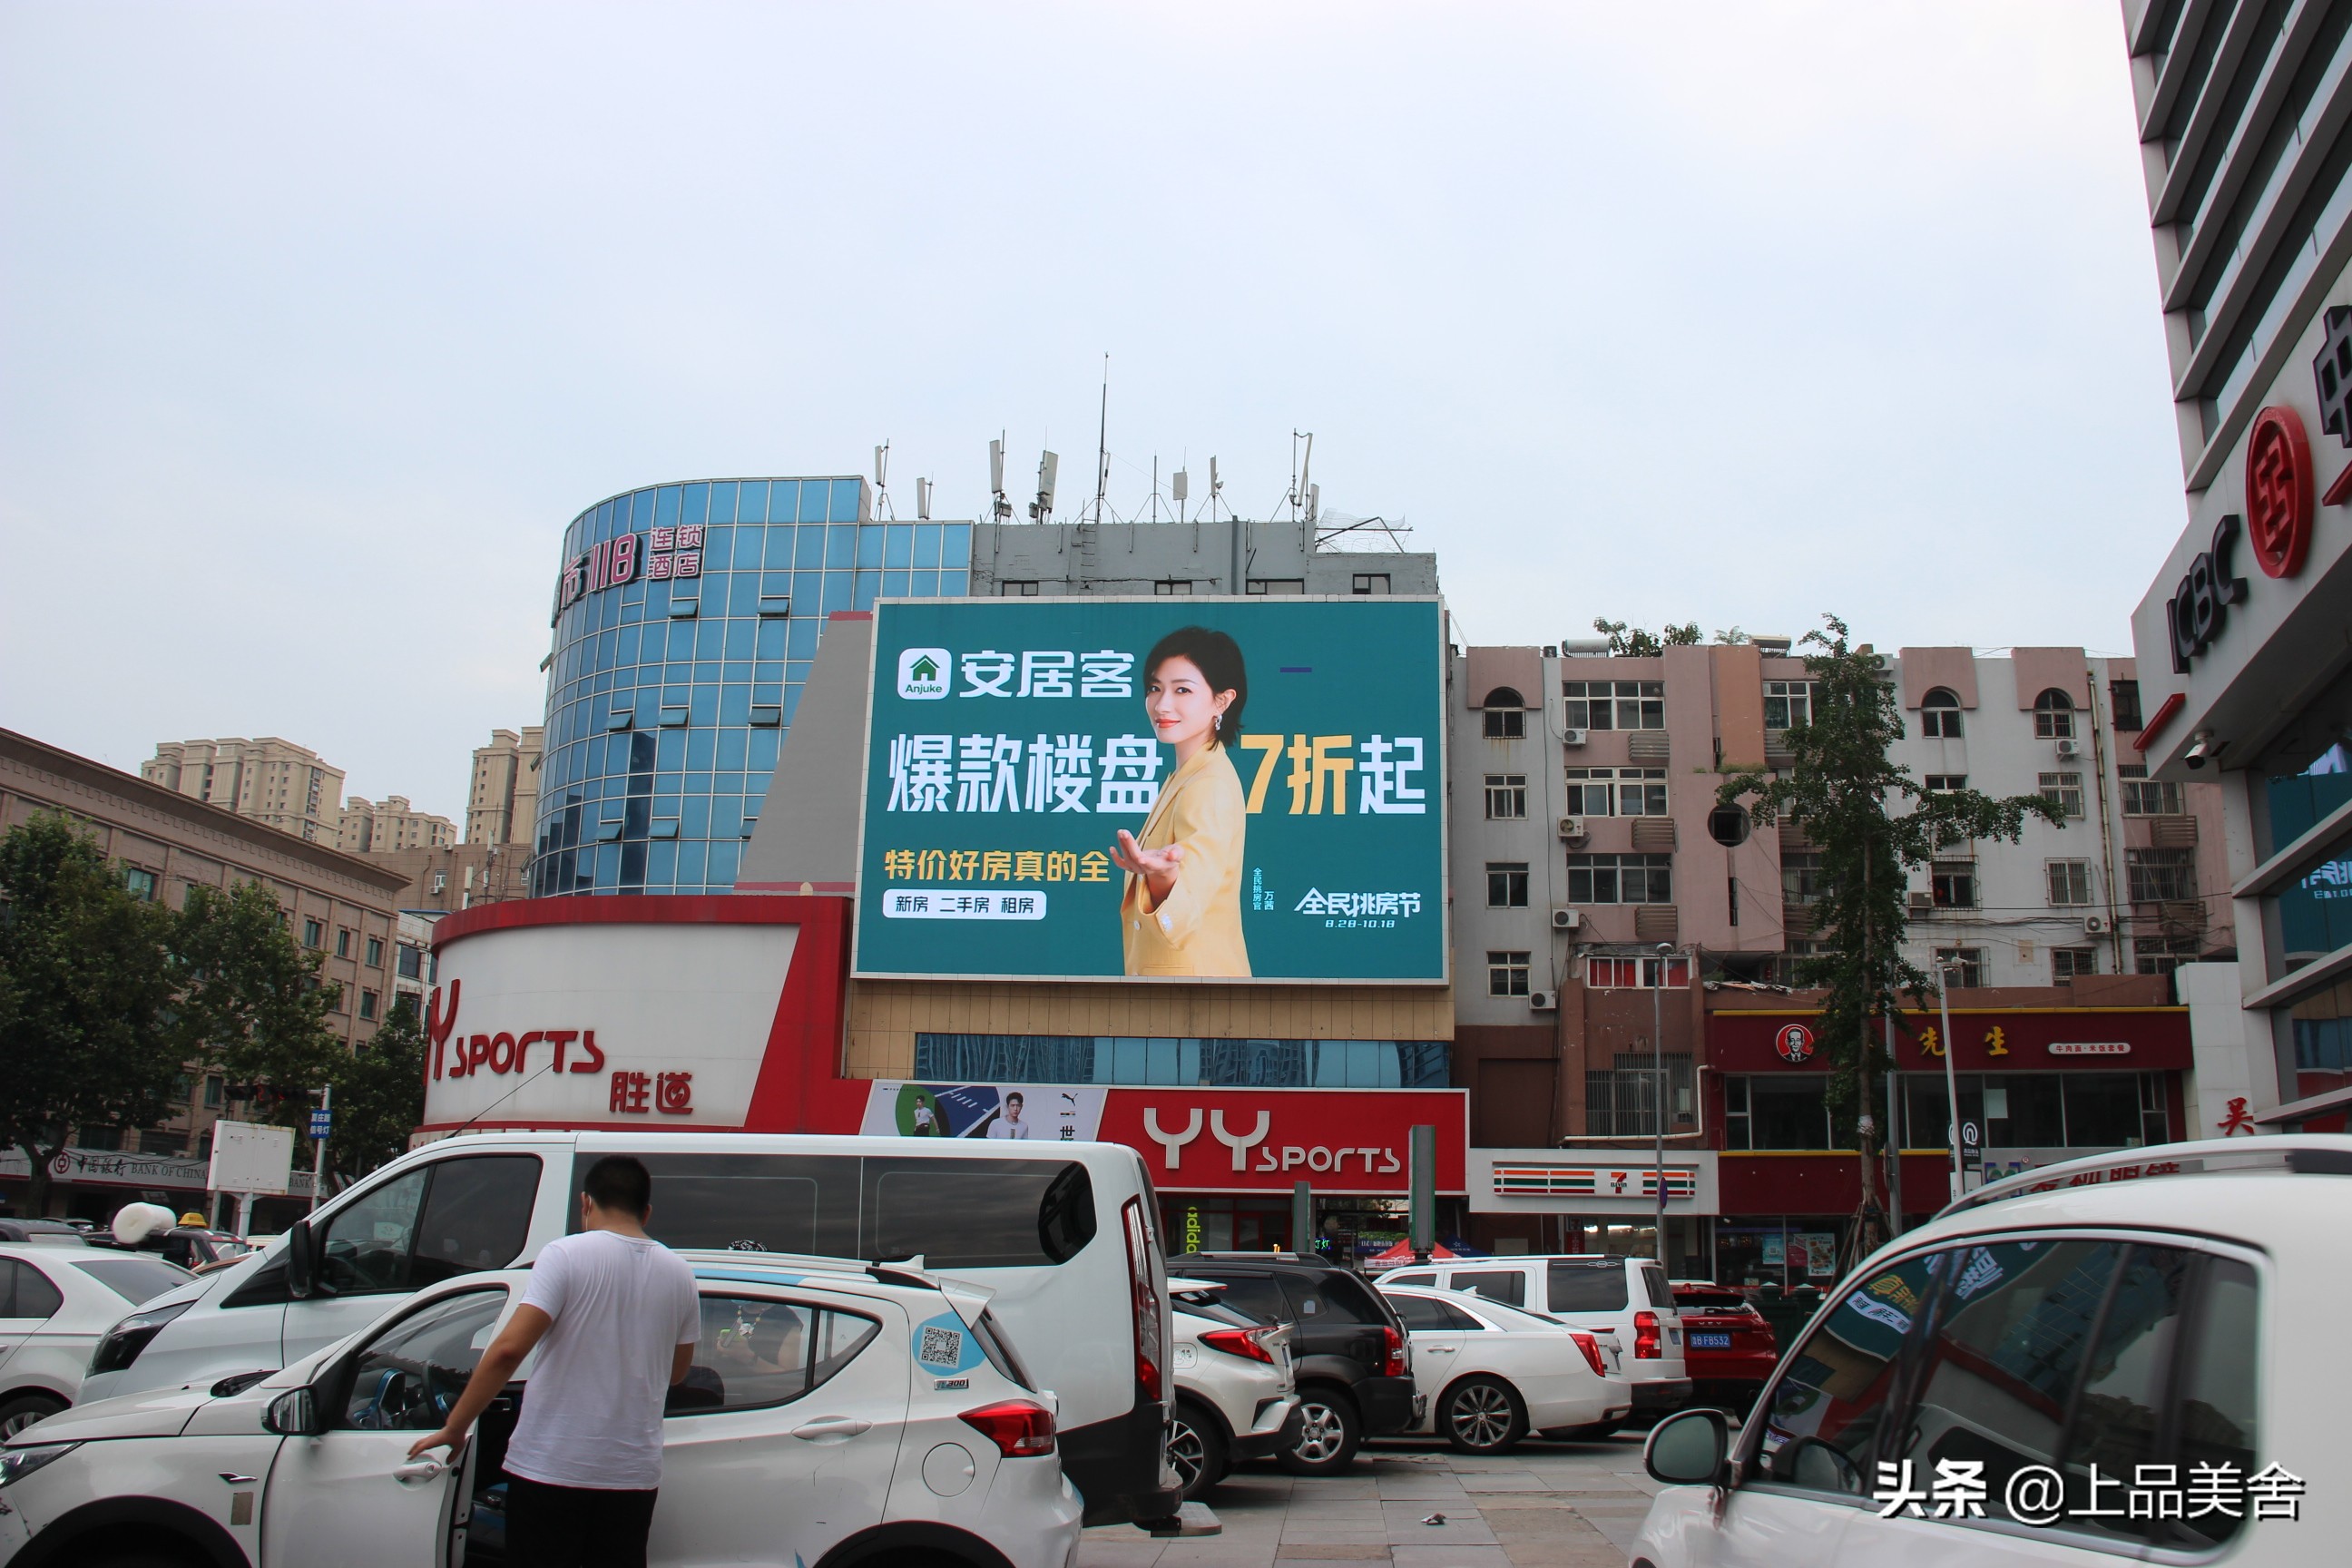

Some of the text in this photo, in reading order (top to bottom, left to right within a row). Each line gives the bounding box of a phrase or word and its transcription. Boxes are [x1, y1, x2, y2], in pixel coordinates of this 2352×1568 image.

[651, 524, 703, 552] 连锁
[555, 533, 637, 610] 市118
[647, 553, 701, 581] 酒店
[2166, 514, 2249, 674] ICBC
[905, 683, 943, 695] Anjuke
[959, 650, 1134, 698] 安居客
[886, 733, 1426, 815] 爆款楼盘 7折起
[884, 849, 1110, 882] 特价好房真的全
[896, 896, 1034, 914] 新房 二手房 租房
[1294, 887, 1421, 918] 全民挑房节
[1325, 919, 1396, 928] 8.28-10.18
[131, 1163, 159, 1175] BANK
[162, 1166, 174, 1177] OF
[1186, 1206, 1201, 1254] adida
